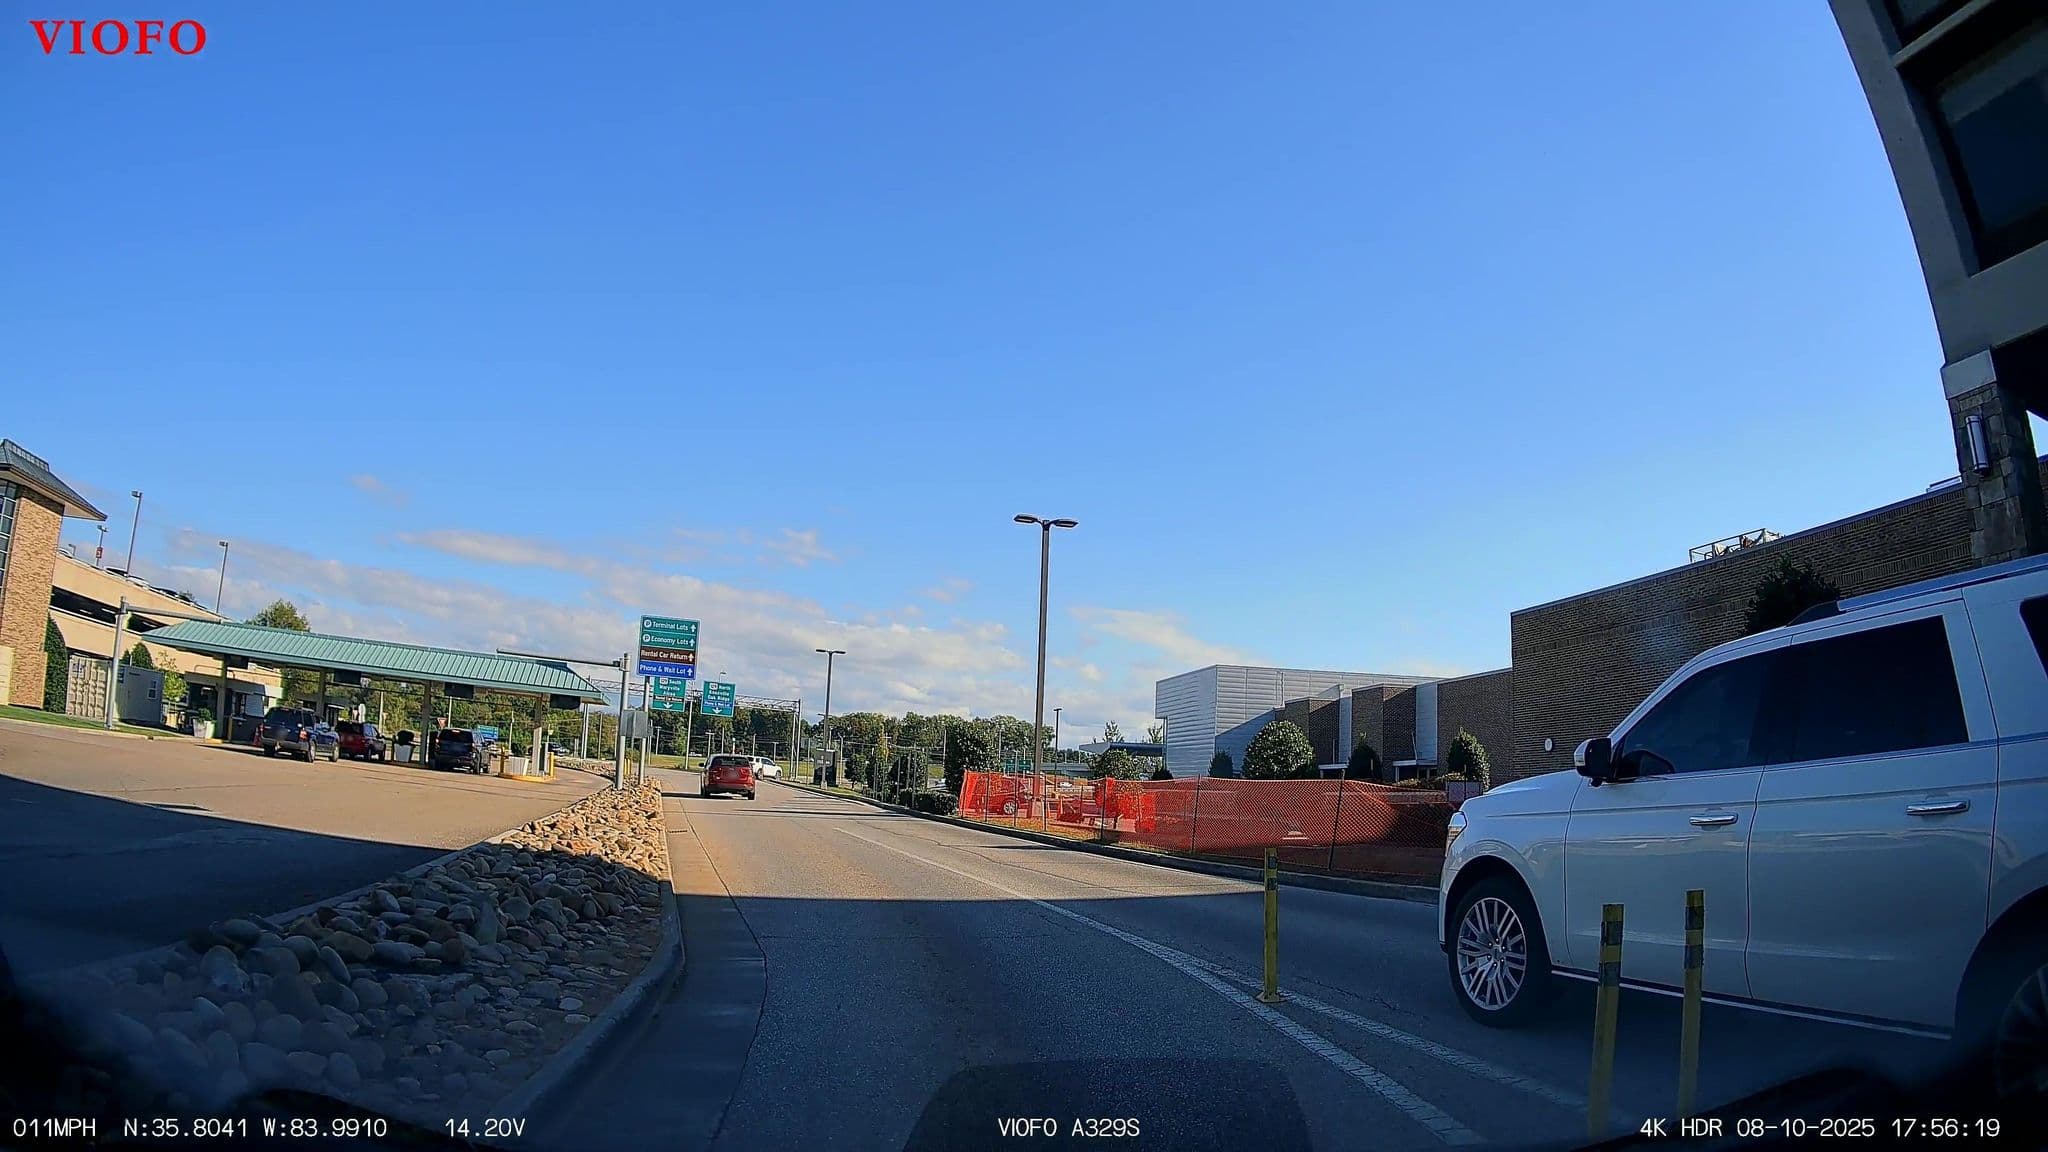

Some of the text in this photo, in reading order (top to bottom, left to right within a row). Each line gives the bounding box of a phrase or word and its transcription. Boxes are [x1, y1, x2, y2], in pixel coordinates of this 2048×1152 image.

[653, 621, 675, 629] Terminal
[676, 623, 688, 631] Lots
[651, 636, 675, 645] Economy
[670, 652, 688, 660] Return
[640, 664, 656, 672] Phone
